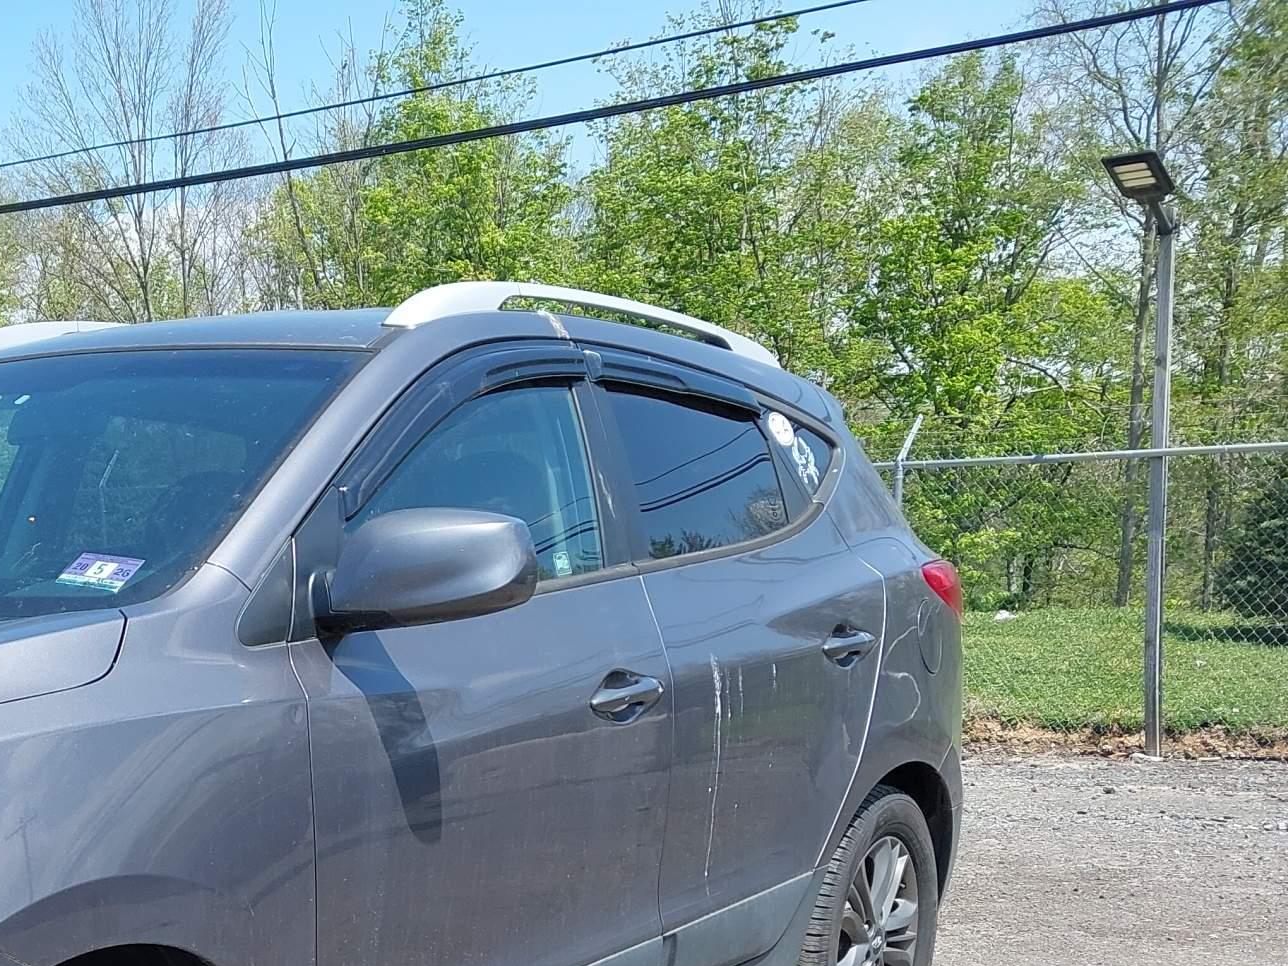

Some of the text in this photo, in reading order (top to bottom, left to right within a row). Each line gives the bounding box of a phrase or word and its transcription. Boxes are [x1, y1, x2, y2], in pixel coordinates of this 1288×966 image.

[71, 561, 132, 578] 20 5 26
